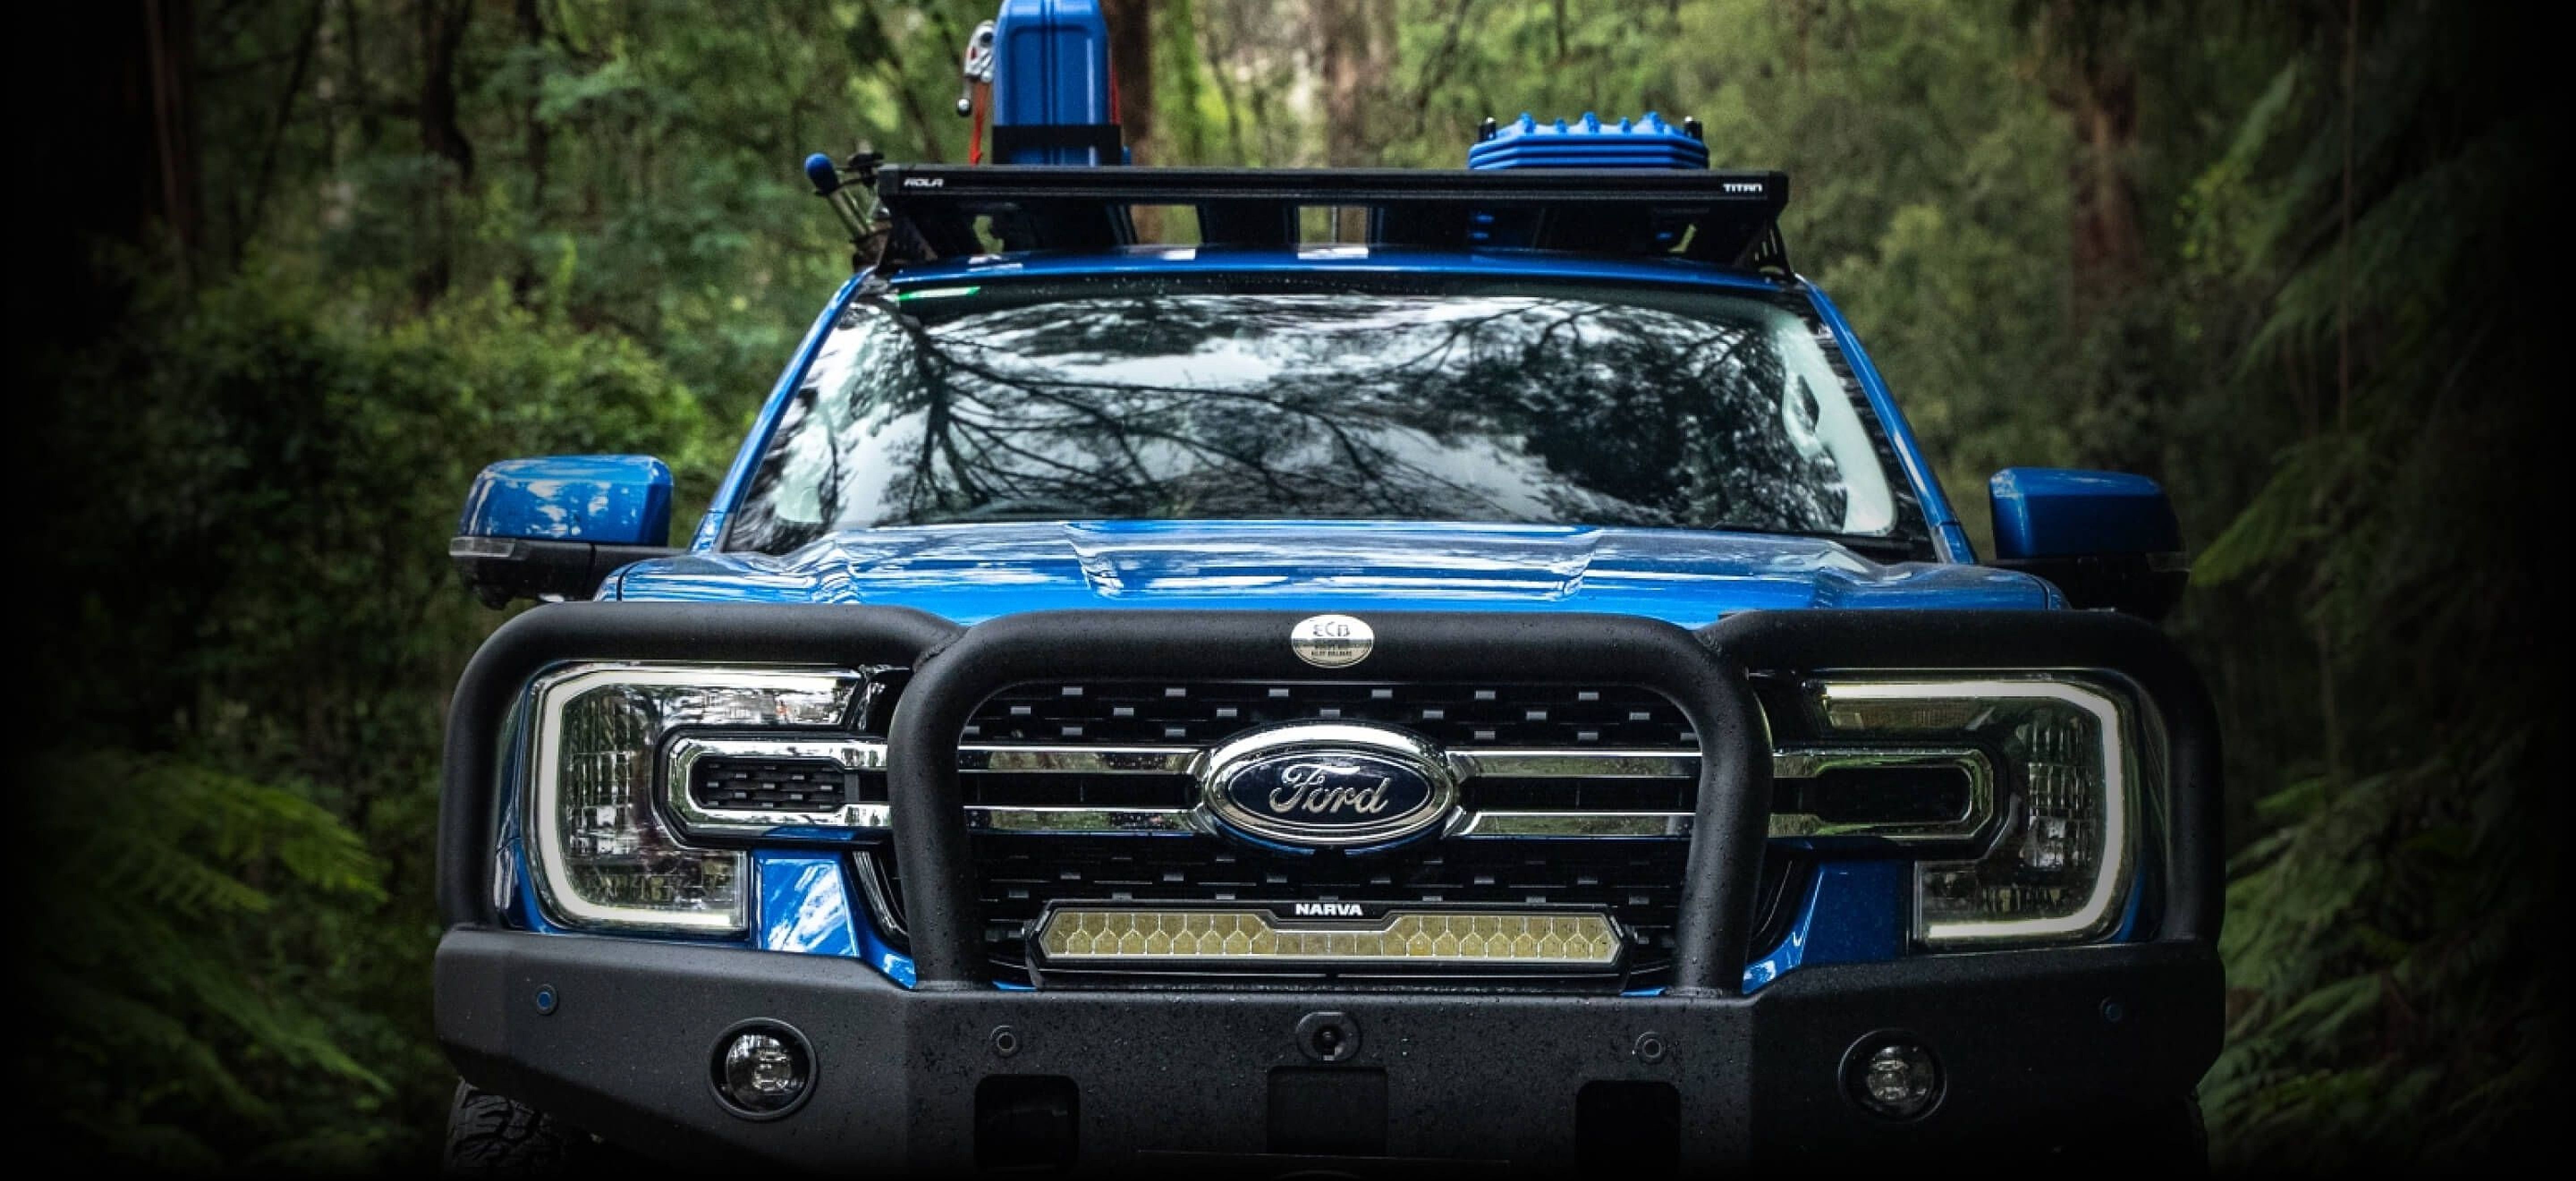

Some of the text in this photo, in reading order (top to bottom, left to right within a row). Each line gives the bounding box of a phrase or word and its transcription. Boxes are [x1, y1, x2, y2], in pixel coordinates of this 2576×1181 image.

[903, 178, 944, 187] ROLA
[1313, 621, 1350, 637] ECB
[1269, 764, 1390, 813] Ford
[1296, 903, 1363, 915] NARVA
